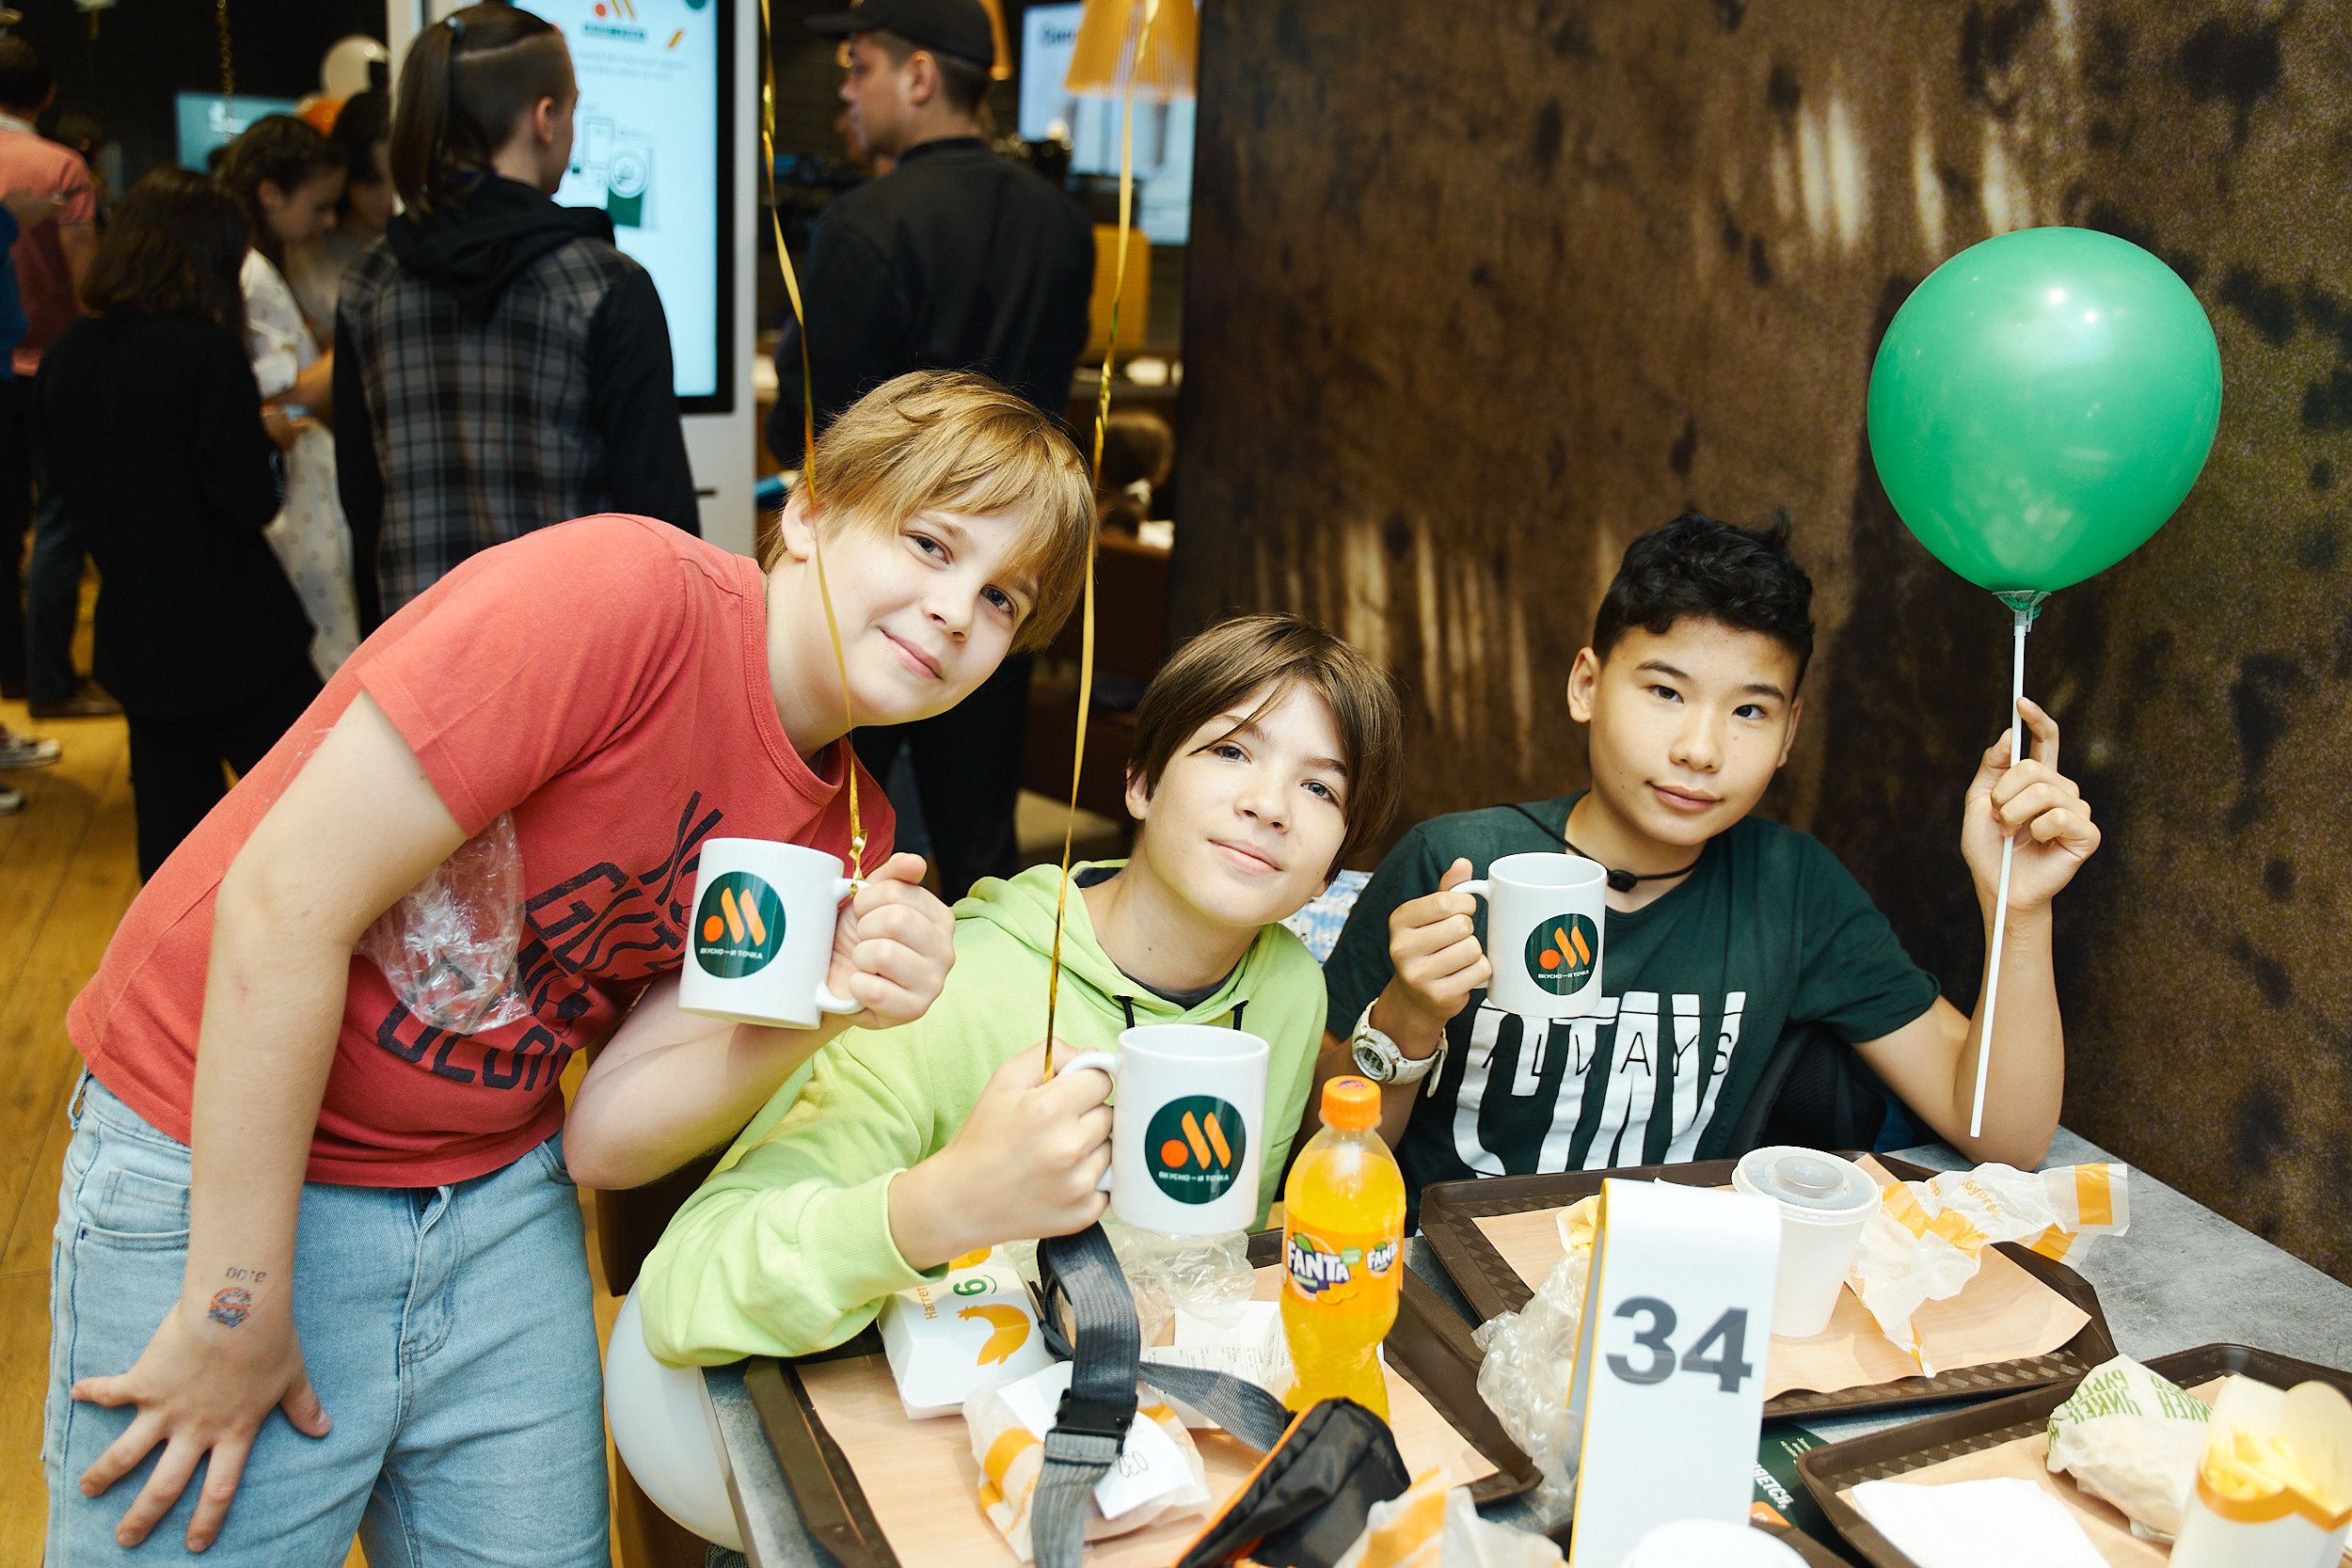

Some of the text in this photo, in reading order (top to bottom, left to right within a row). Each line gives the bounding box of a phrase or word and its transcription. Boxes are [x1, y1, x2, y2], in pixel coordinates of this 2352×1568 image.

[700, 947, 724, 956] ВКУСНО
[1287, 1238, 1352, 1282] FANTA
[953, 1278, 987, 1296] 6
[1606, 1295, 1753, 1394] 34
[2068, 1389, 2143, 1425] ЧИКЕН
[2153, 1390, 2212, 1423] ИКЕН
